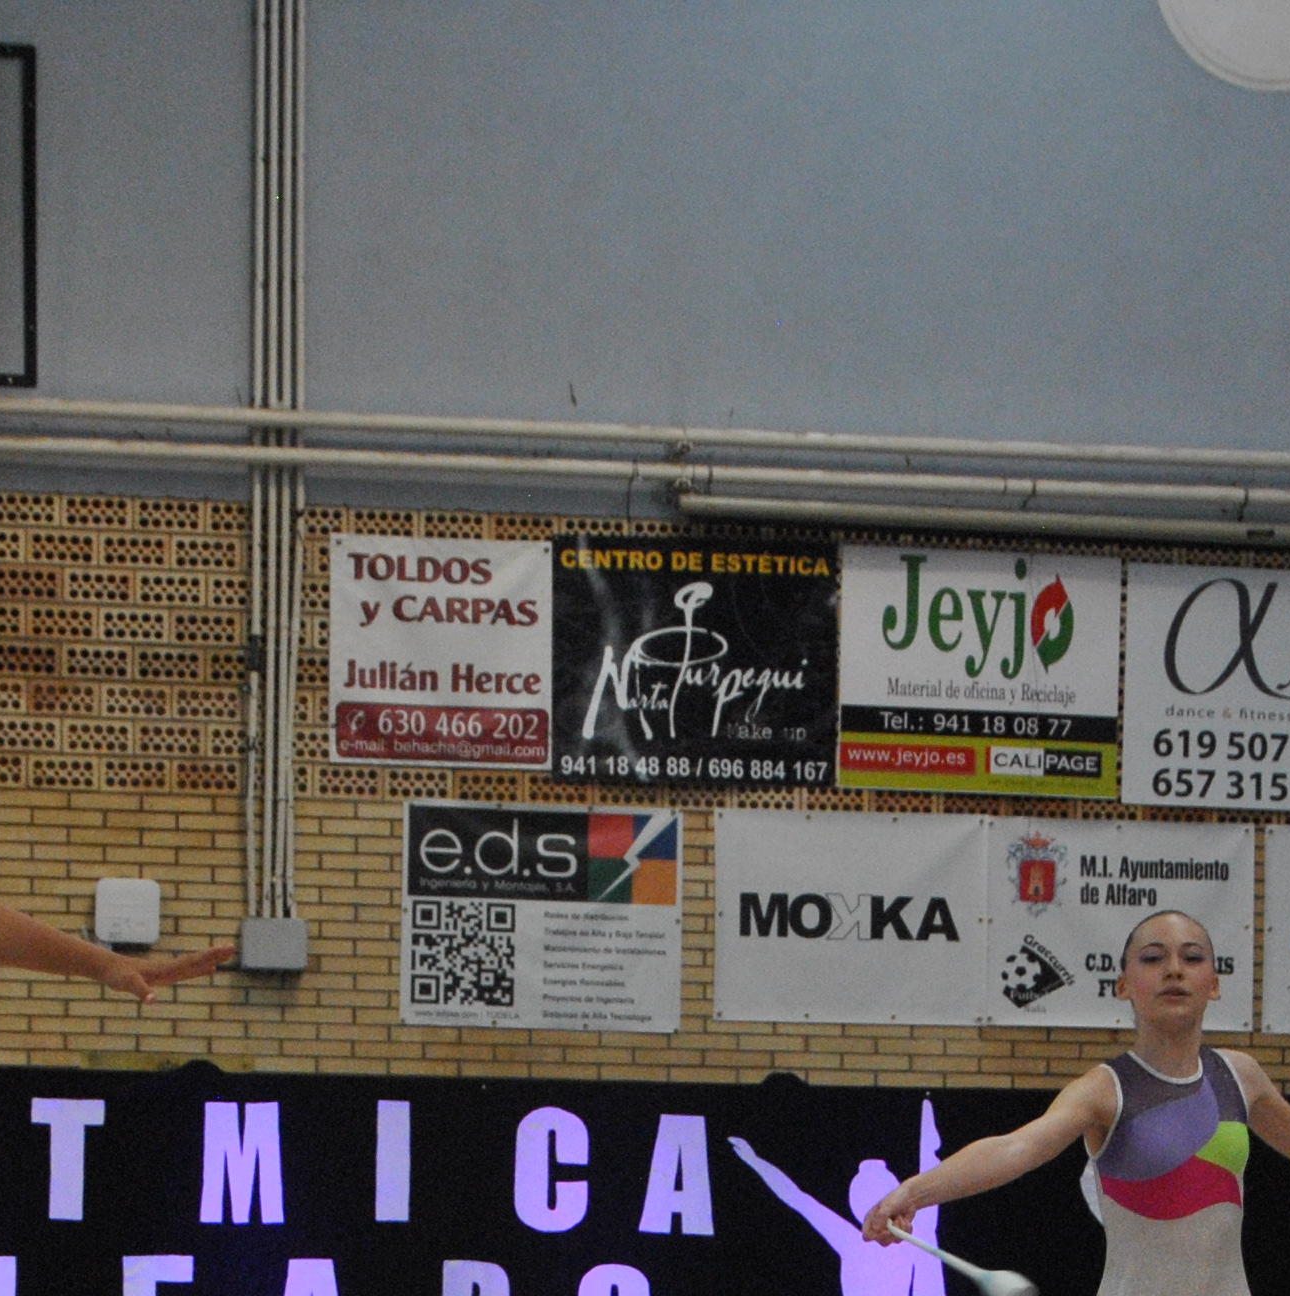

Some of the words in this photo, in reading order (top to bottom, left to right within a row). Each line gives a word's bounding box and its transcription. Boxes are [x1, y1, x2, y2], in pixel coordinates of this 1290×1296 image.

[347, 552, 493, 585] TOLDOS
[560, 549, 663, 571] CENTRO
[672, 551, 702, 572] DE
[711, 550, 830, 576] ESTÉTICA
[359, 599, 380, 626] y
[392, 596, 539, 627] CARPAS
[343, 659, 439, 693] Julián
[451, 662, 541, 696] Herce
[887, 677, 942, 698] Material
[945, 680, 961, 698] de
[964, 680, 1006, 701] oficina
[1010, 687, 1017, 705] y
[1021, 684, 1077, 708] Reciclaje
[378, 709, 426, 735] 630
[435, 712, 483, 738] 466
[492, 713, 539, 740] 202
[879, 710, 924, 731] Tel.:
[933, 713, 971, 733] 941
[981, 716, 1006, 733] 18
[1013, 717, 1039, 736] 08
[1048, 718, 1073, 737] 77
[1165, 704, 1216, 719] dance
[847, 748, 966, 767] www.jeyjo.es
[1153, 727, 1217, 759] 619
[1226, 732, 1289, 762] 507
[561, 755, 597, 775] 941
[605, 755, 629, 775] 18
[636, 756, 660, 776] 48
[666, 757, 691, 776] 88
[695, 758, 704, 777] /
[709, 758, 744, 778] 696
[750, 760, 786, 779] 884
[793, 761, 828, 780] 167
[1152, 768, 1216, 798] 657
[1226, 770, 1288, 801] 315
[418, 819, 579, 879] e.d.s
[1079, 855, 1113, 880] M.I.
[1118, 855, 1230, 883] Ayuntamiento
[1079, 883, 1100, 905] de
[1104, 883, 1158, 908] Alfaro
[1084, 953, 1116, 972] C.D.
